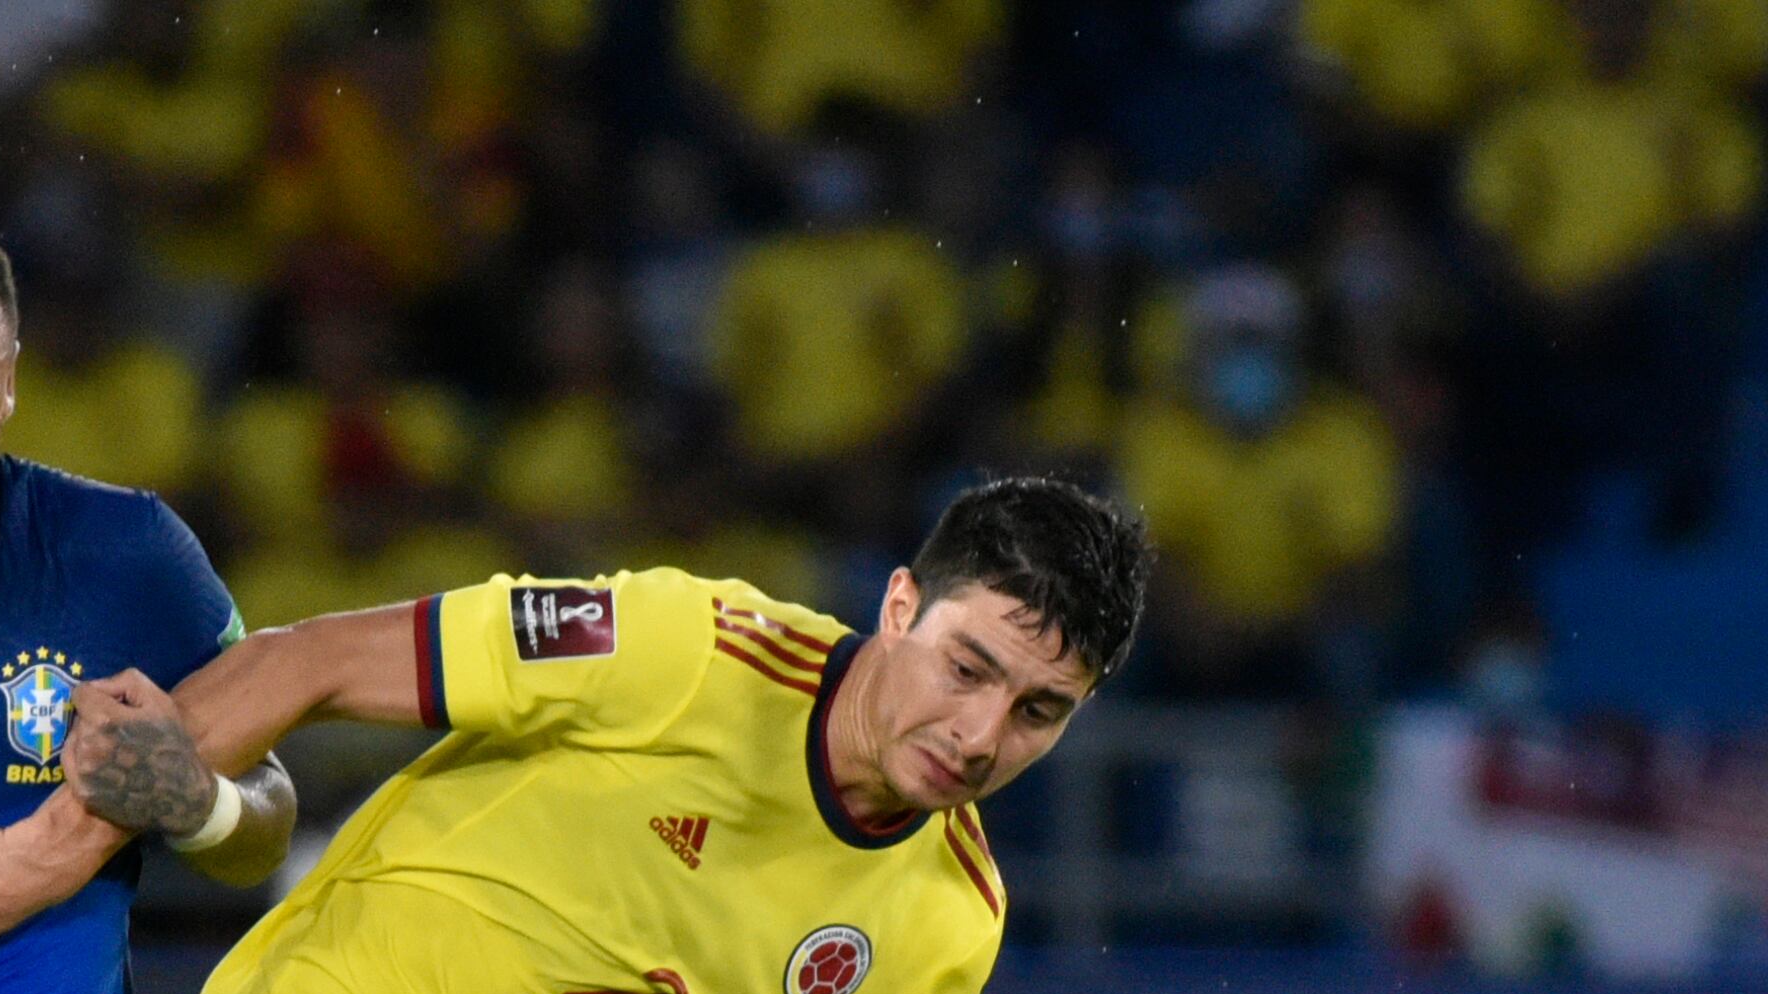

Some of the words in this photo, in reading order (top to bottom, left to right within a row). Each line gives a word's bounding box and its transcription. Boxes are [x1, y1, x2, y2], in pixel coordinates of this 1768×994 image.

[29, 703, 56, 717] CBF
[6, 763, 66, 783] BRAS
[649, 815, 702, 871] adidas
